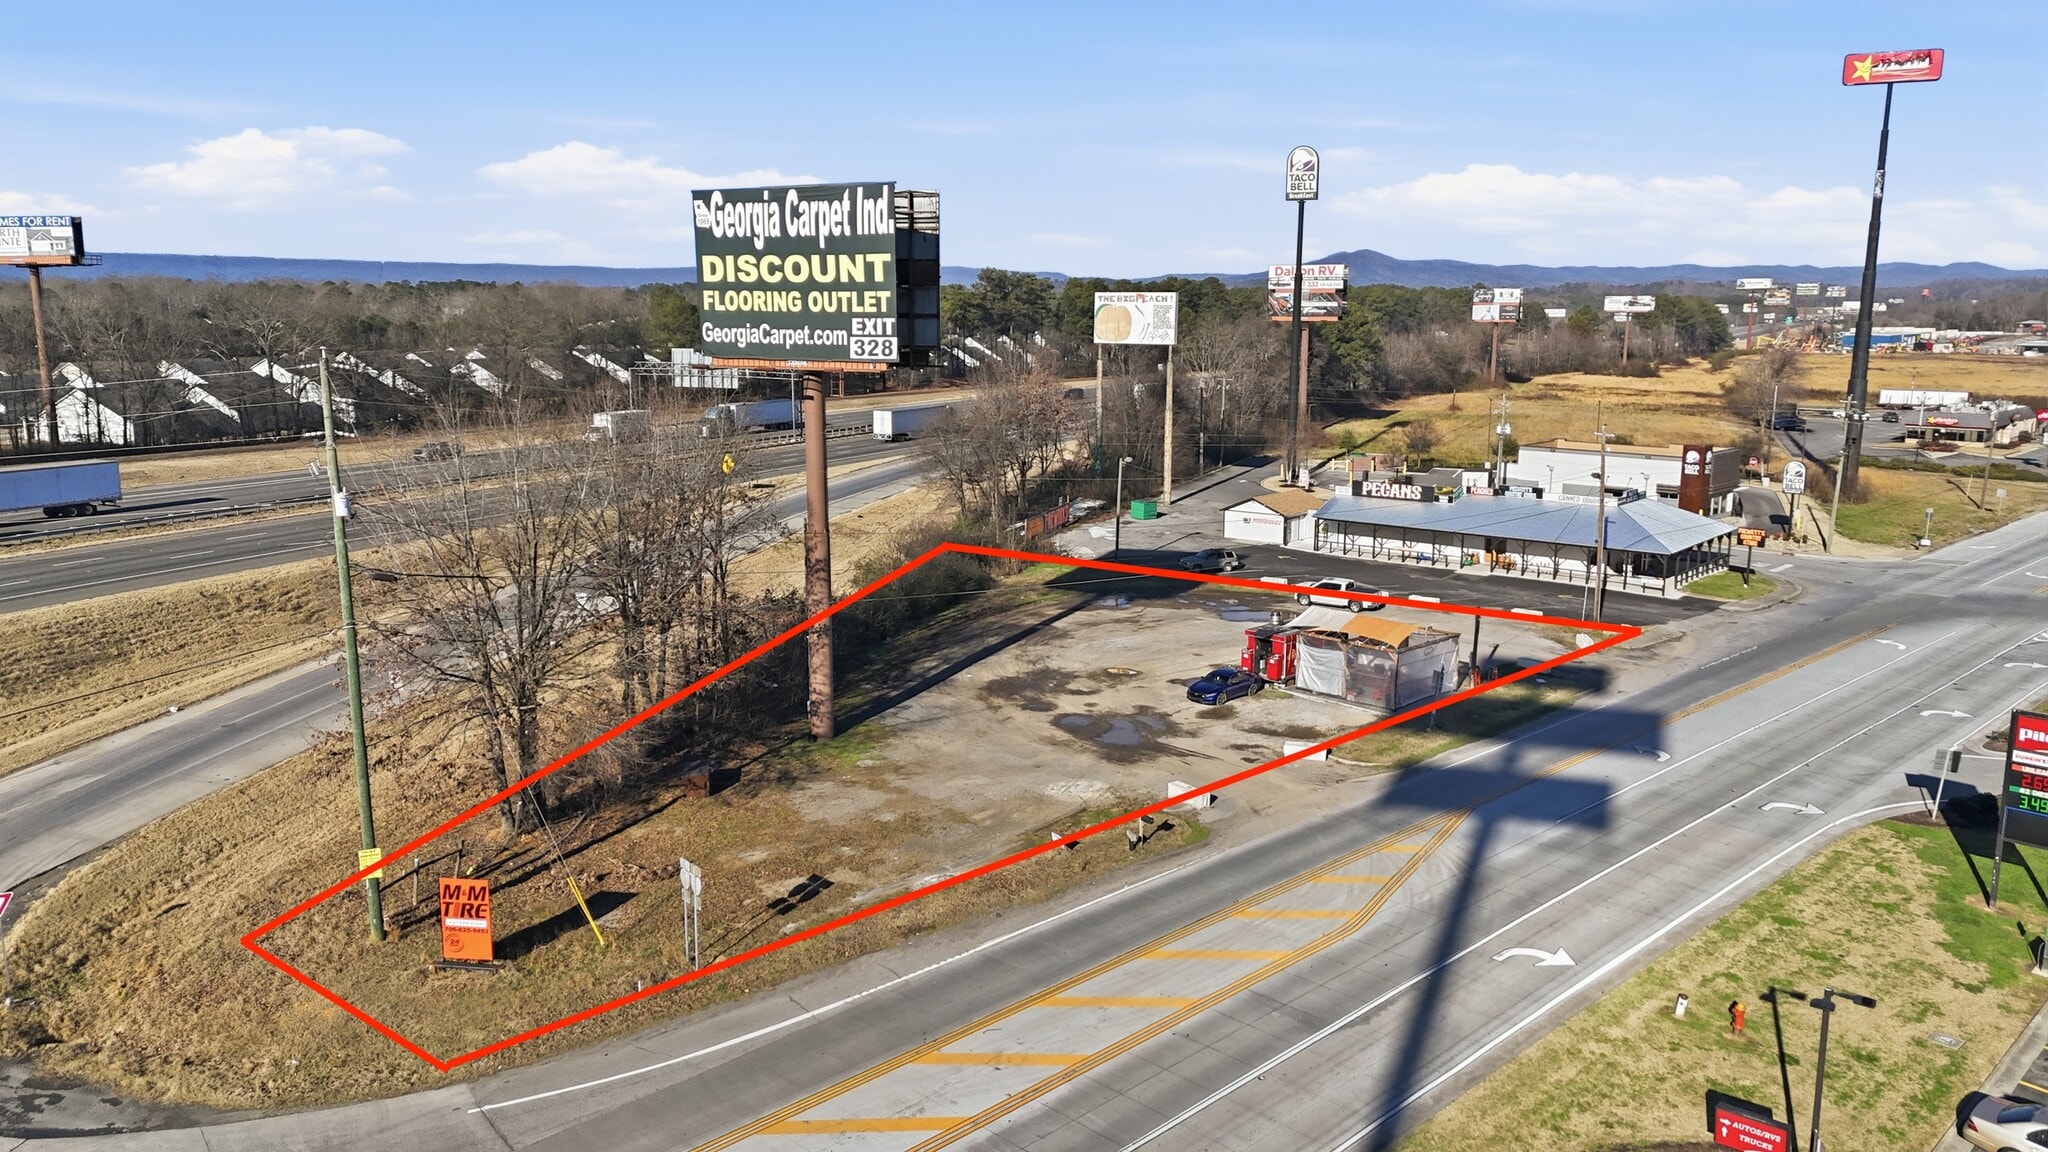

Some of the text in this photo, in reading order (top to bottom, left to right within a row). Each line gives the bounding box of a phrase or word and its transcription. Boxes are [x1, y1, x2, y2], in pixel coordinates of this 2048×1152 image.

[1289, 173, 1316, 182] TACO
[22, 216, 43, 226] FOR
[45, 216, 70, 226] RENT
[710, 184, 895, 250] Georgia Carpet Ind.
[702, 253, 891, 283] DISCOUNT
[1275, 266, 1336, 276] Dalon RV
[703, 290, 891, 313] FLOORING OUTLET
[702, 322, 848, 349] GeorgiaCarpet.com
[852, 318, 896, 335] EXIT
[853, 339, 893, 357] 328
[1362, 481, 1423, 500] PECANS
[442, 884, 487, 902] M&M
[442, 902, 488, 919] TIRE
[1732, 1122, 1781, 1142] AUTOS/RVS
[1739, 1134, 1774, 1151] TRUCKS
